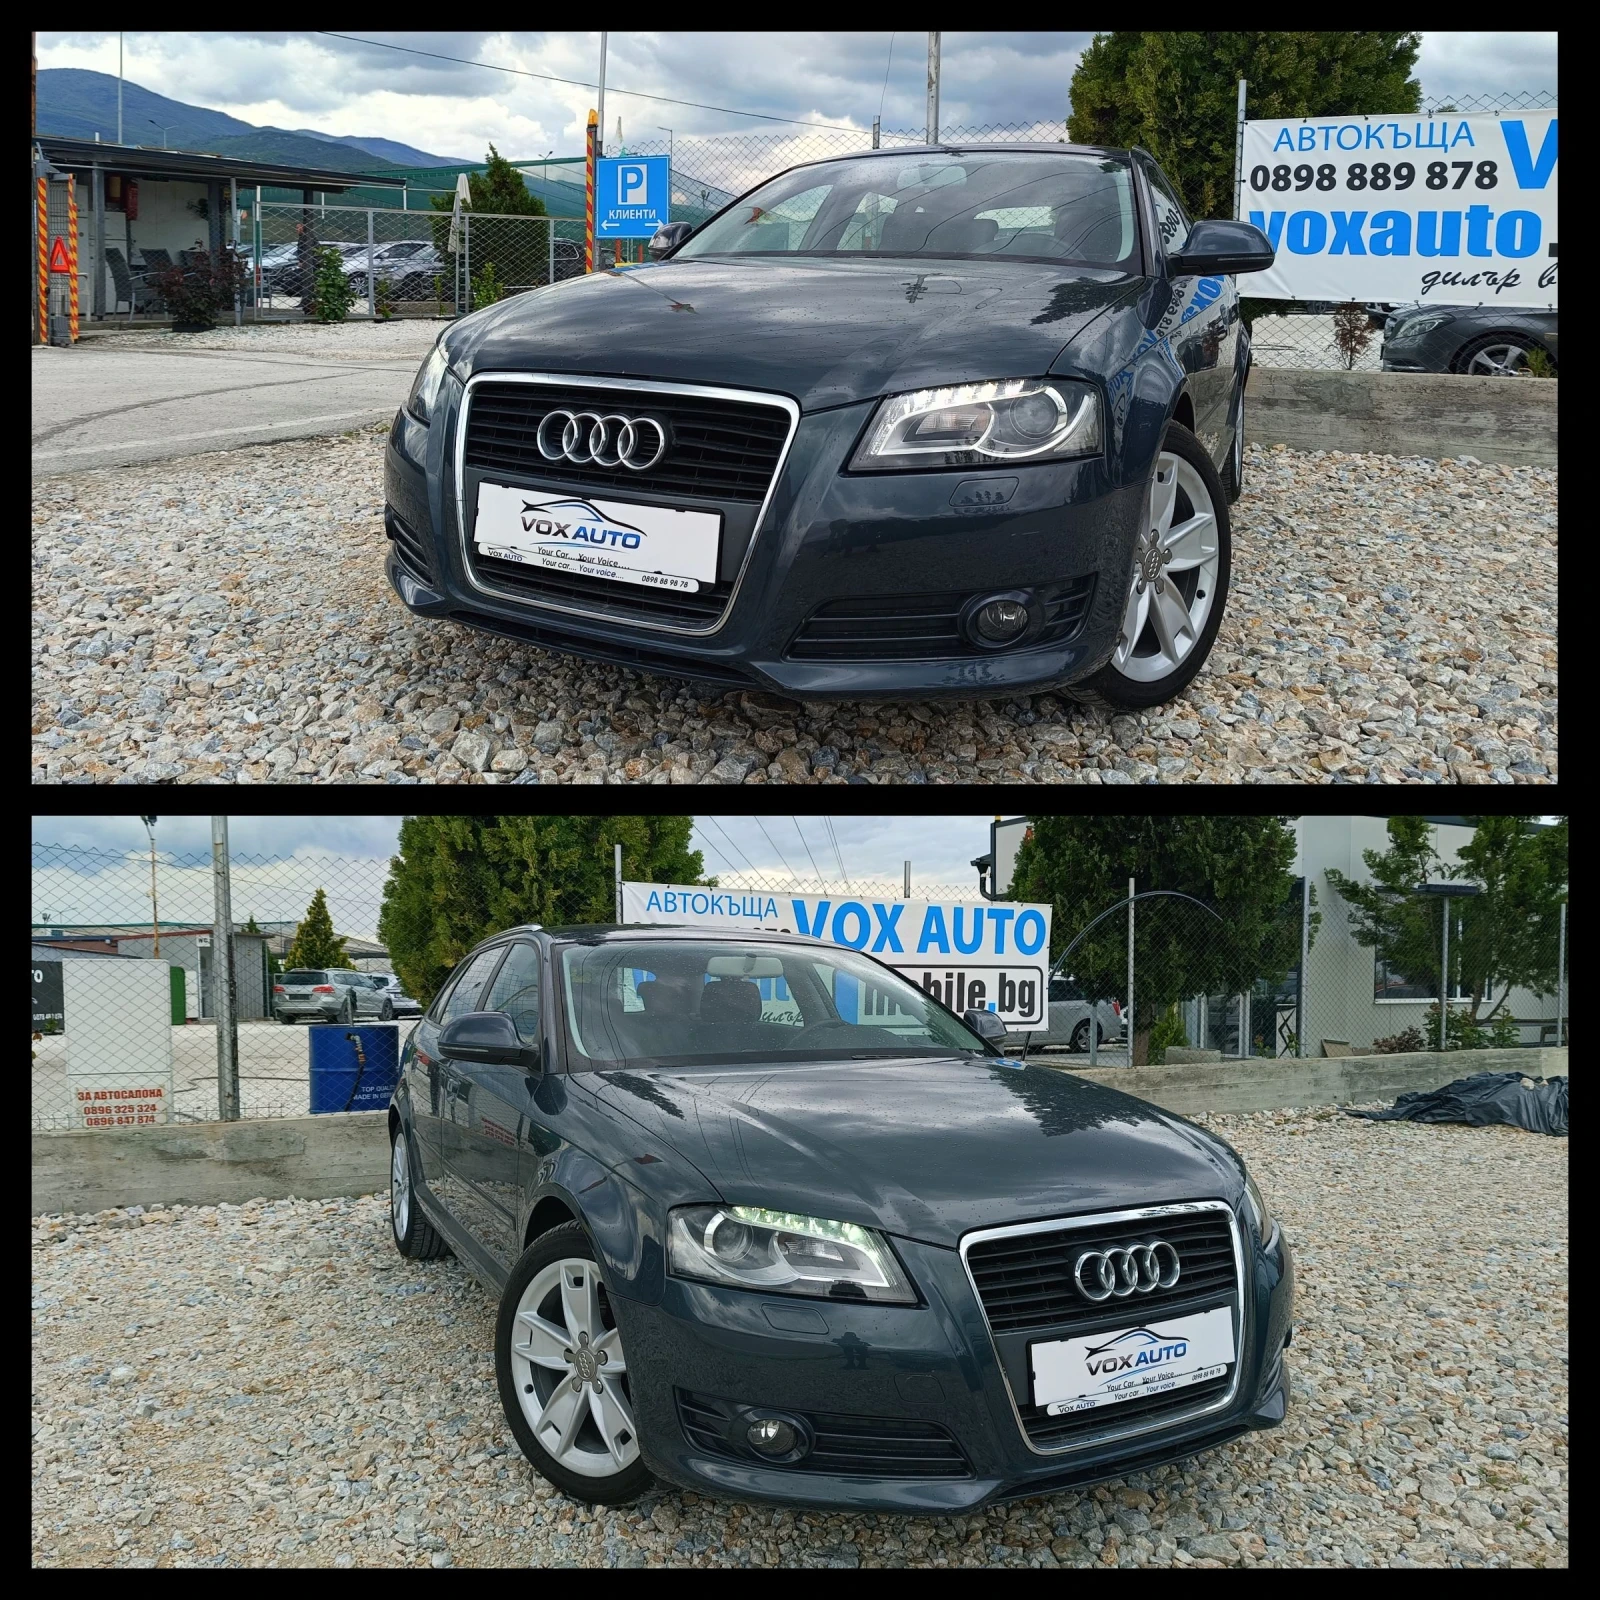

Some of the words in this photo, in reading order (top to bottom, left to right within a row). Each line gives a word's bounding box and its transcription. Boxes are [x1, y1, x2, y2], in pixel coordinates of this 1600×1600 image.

[1273, 121, 1476, 154] АВТОКЪЩА
[1250, 163, 1338, 192] 0898
[1346, 162, 1416, 191] 889
[1425, 160, 1499, 190] 878
[621, 167, 643, 203] P
[609, 209, 656, 219] КЛИЕНТИ
[520, 516, 571, 539] VOX
[572, 525, 641, 550] AUTO
[488, 550, 503, 558] VOX
[503, 553, 523, 562] AUTO
[538, 546, 554, 557] Your
[542, 558, 557, 567] Your
[579, 564, 594, 574] Your
[641, 575, 658, 584] 0898
[660, 577, 669, 585] 88
[669, 578, 679, 587] 98
[680, 580, 689, 588] 78
[646, 891, 778, 922] АВТОКЪЩА
[791, 900, 905, 953] VOX
[916, 906, 1046, 956] AUTO
[77, 1091, 91, 1101] ЗА
[94, 1089, 162, 1100] АВТОСАЛОНА
[84, 1106, 112, 1115] 0896
[114, 1105, 134, 1113] 325
[137, 1104, 157, 1112] 324
[87, 1117, 114, 1126] 0896
[1086, 1353, 1133, 1376] VOX
[1135, 1342, 1187, 1367] AUTO
[1107, 1384, 1122, 1392] Your
[1146, 1384, 1159, 1393] Your
[1059, 1405, 1074, 1413] VOX
[1075, 1401, 1096, 1410] AUTO
